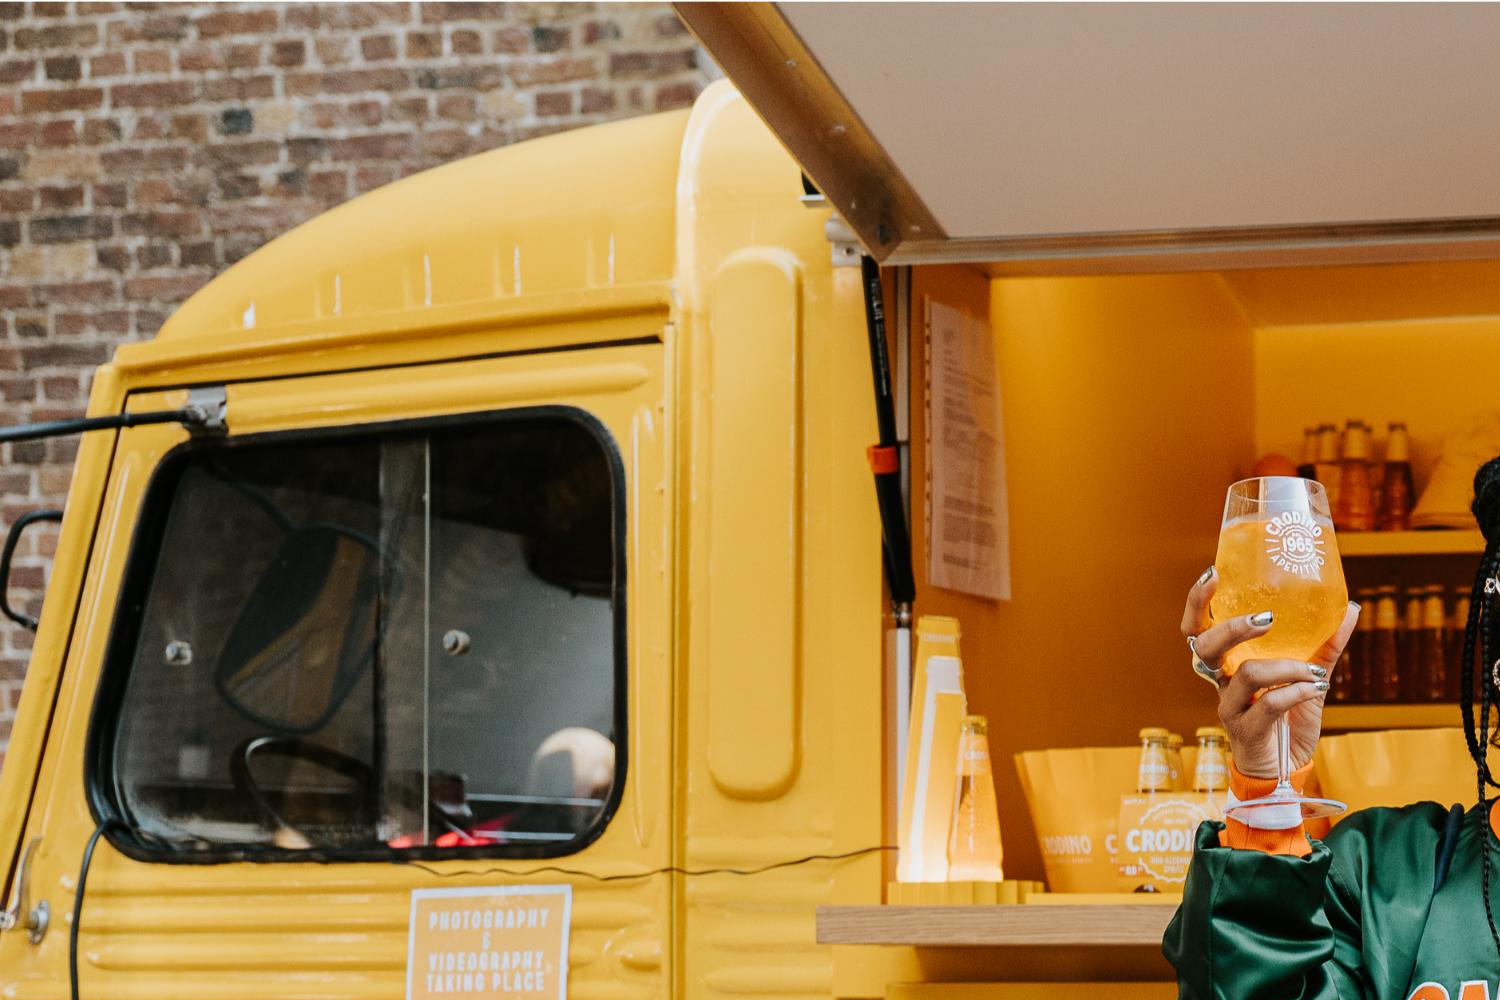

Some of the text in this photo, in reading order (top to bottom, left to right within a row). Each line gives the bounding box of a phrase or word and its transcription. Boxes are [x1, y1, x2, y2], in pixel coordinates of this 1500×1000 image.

[1265, 510, 1322, 538] CRODINO
[1283, 537, 1315, 553] 1965
[1270, 554, 1325, 575] APERITIVO
[1126, 828, 1192, 853] CRODI
[428, 907, 549, 930] PHOTOGRAPHY
[428, 950, 544, 972] VIDEOGRAPHY
[427, 971, 545, 993] TAKING PLACE
